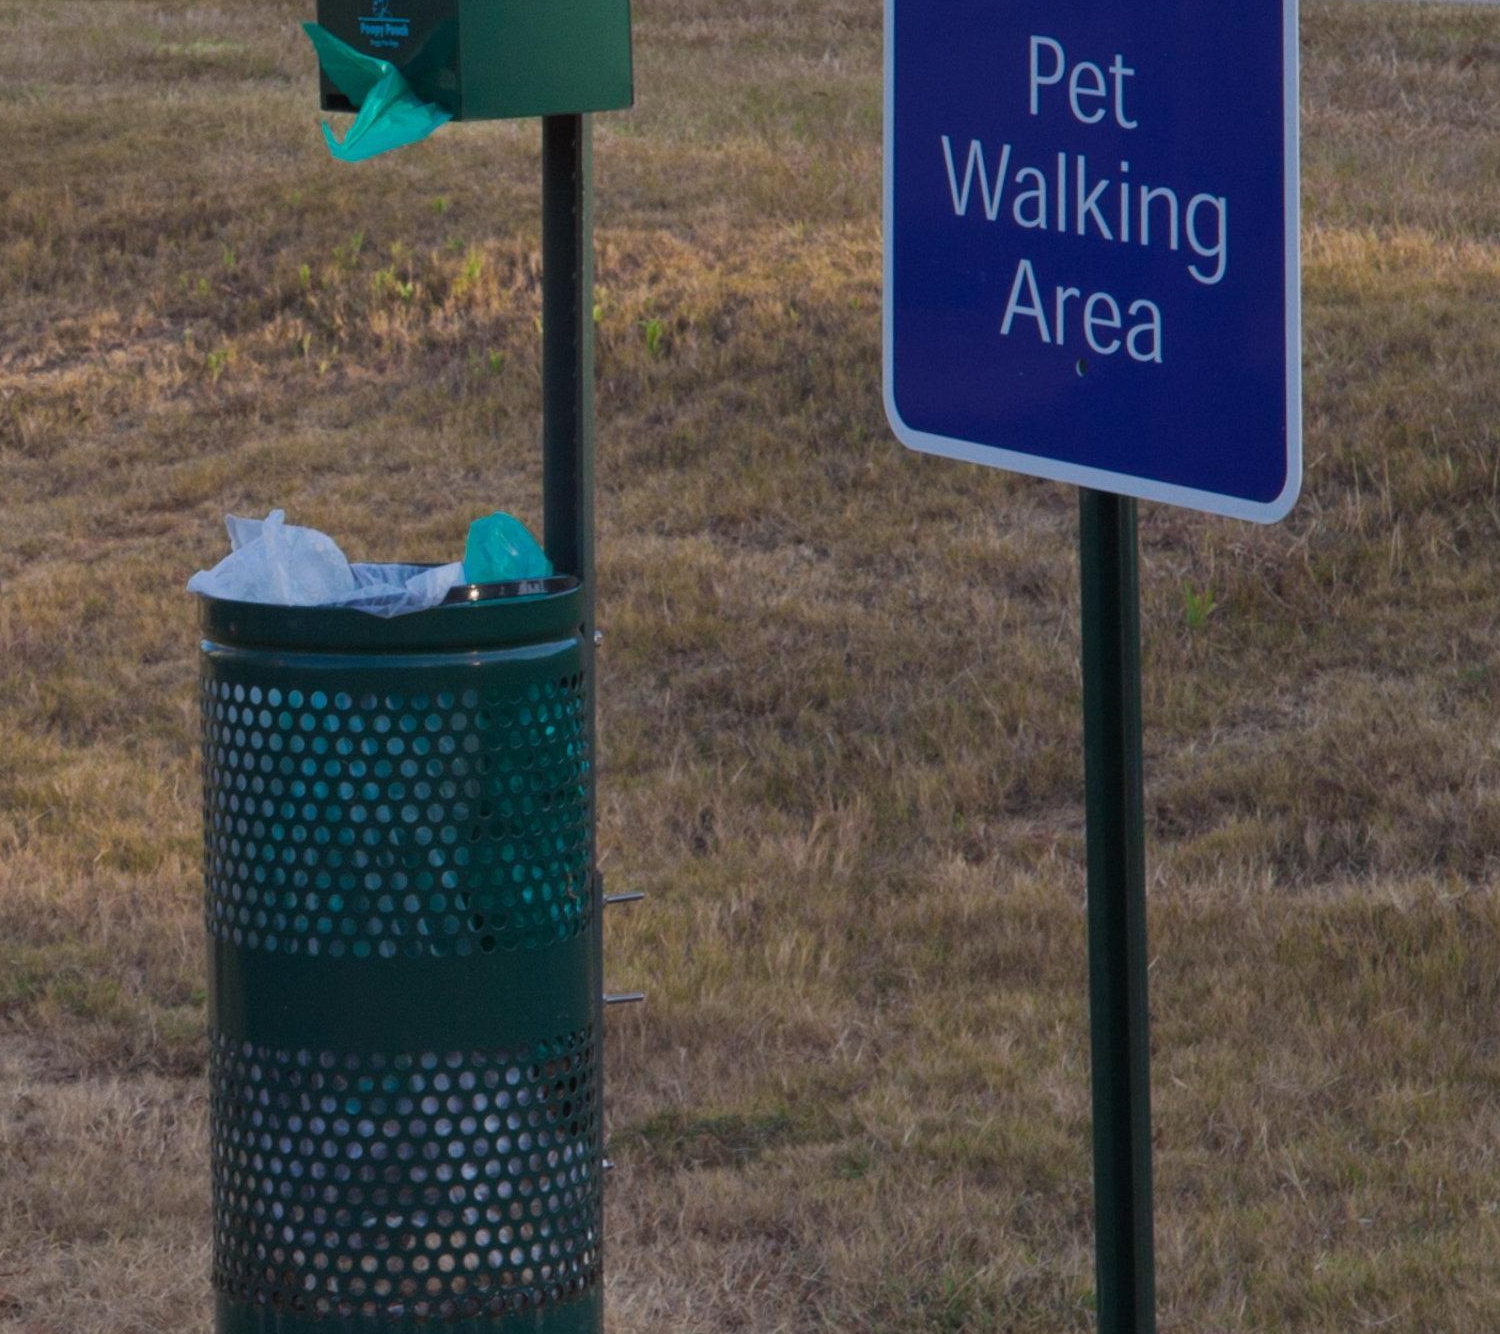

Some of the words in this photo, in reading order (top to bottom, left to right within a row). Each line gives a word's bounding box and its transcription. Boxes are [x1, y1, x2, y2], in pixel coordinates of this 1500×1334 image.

[1028, 34, 1138, 130] Pet
[940, 134, 1227, 285] Walking
[999, 258, 1163, 364] Area
